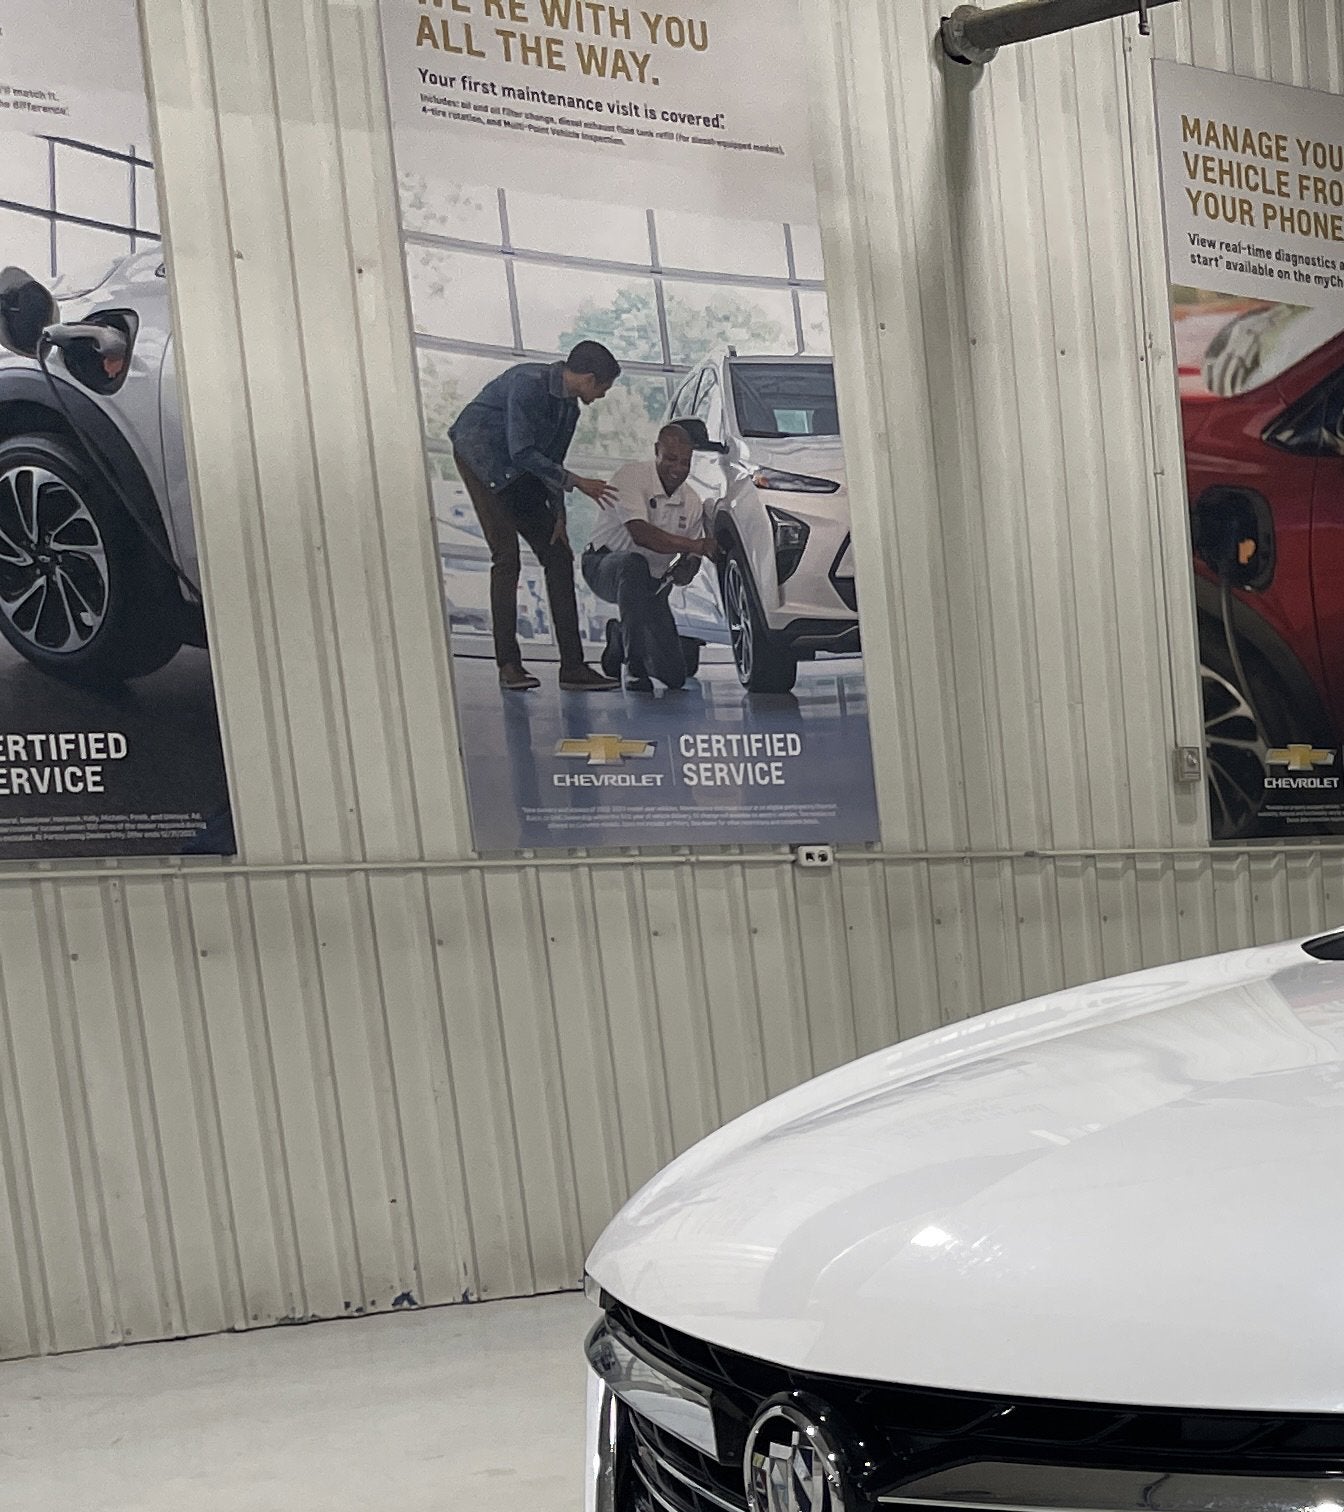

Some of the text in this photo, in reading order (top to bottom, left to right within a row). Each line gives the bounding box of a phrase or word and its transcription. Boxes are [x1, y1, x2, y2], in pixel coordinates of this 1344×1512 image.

[540, 0, 631, 40] WITH
[641, 11, 709, 52] YOU
[416, 15, 660, 86] ALL THE WAY.
[418, 67, 457, 88] Your
[461, 75, 498, 97] first
[502, 86, 603, 113] maintenance
[607, 100, 640, 118] visit
[644, 103, 657, 121] is
[1180, 114, 1290, 163] MANAGE
[1182, 150, 1291, 199] VEHICLE
[1184, 186, 1256, 228] YOUR
[1187, 232, 1216, 250] View
[1218, 239, 1272, 260] real-time
[1274, 248, 1337, 270] diagnostics
[1225, 259, 1274, 278] available
[1277, 268, 1291, 280] on
[1293, 269, 1311, 284] the
[679, 733, 802, 758] CERTIFIED
[552, 774, 664, 787] CHEVROLET
[682, 762, 786, 787] SERVICE
[1264, 777, 1340, 789] CHEVROLET
